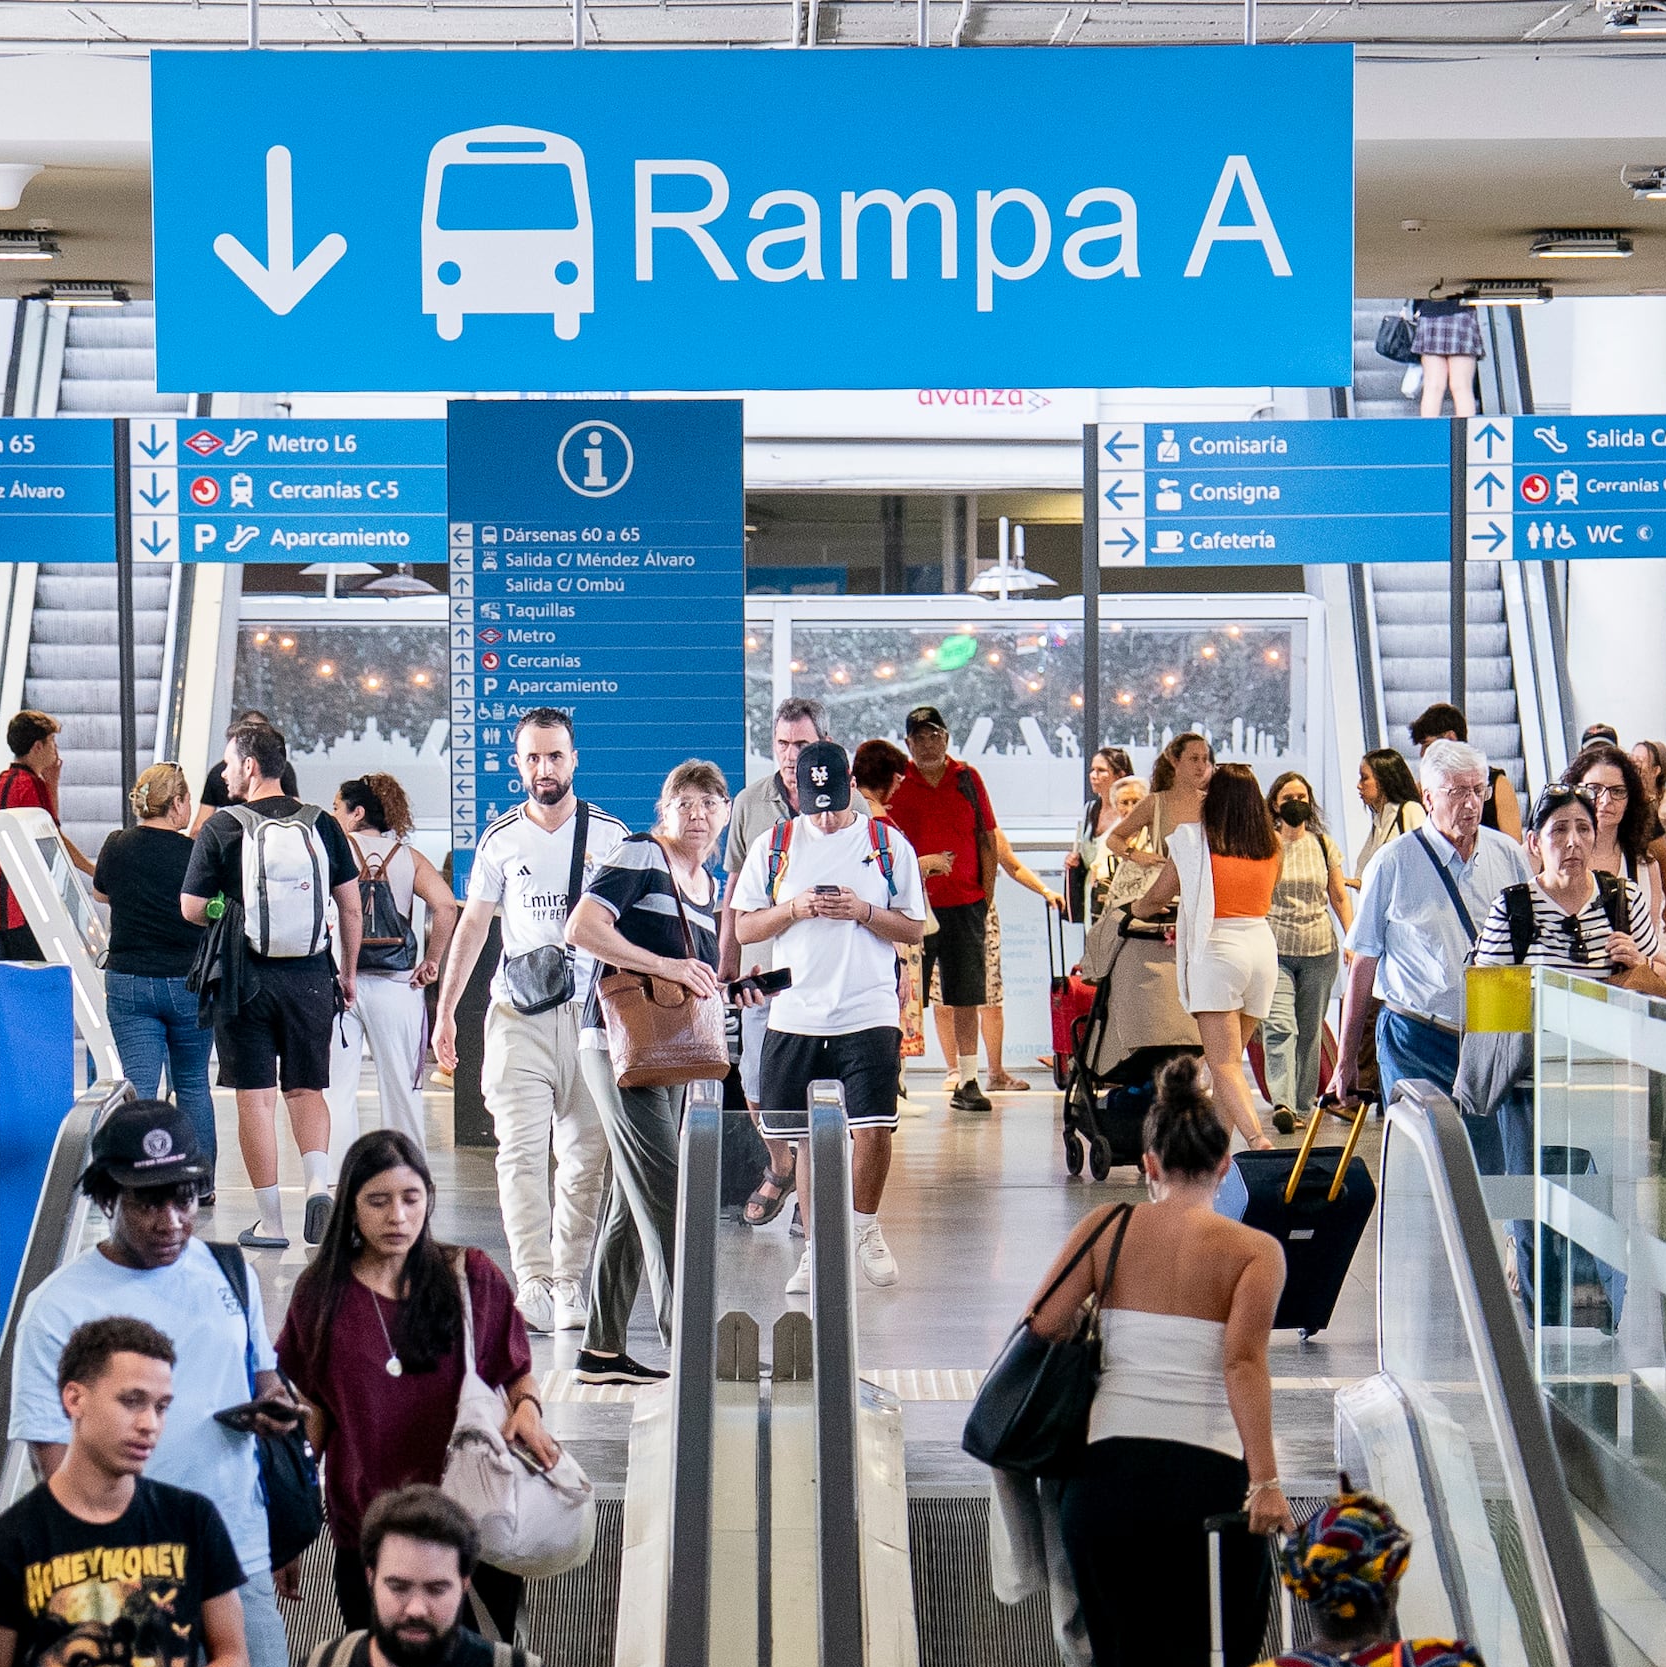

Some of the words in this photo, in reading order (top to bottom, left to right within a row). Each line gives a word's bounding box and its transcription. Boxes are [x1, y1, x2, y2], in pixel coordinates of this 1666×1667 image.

[634, 158, 1141, 313] Rampa
[1183, 155, 1293, 277] A
[918, 388, 1023, 405] avanza
[9, 435, 35, 454] 65
[267, 434, 328, 454] Metro
[332, 434, 357, 454] L6
[1189, 434, 1288, 456] Comisaría
[1587, 428, 1645, 448] Salida
[10, 480, 65, 498] Álvaro
[269, 479, 362, 500] Cercanías
[367, 481, 399, 499] C-5
[1189, 481, 1281, 505] Consigna
[1586, 475, 1659, 493] Cercanías
[270, 527, 410, 549] Aparcamiento
[503, 527, 577, 542] Dársenas
[581, 527, 602, 542] 60
[606, 531, 616, 542] a
[620, 527, 640, 542] 65
[1189, 529, 1276, 551] Cafetería
[1587, 524, 1624, 543] WC
[506, 552, 552, 567] Salida
[557, 552, 571, 567] C/
[577, 551, 639, 567] Méndez
[644, 550, 695, 567] Álvaro
[506, 577, 552, 592] Salida
[557, 577, 572, 592] C/
[577, 577, 625, 592] Ombú
[506, 602, 575, 620] Taquillas
[507, 629, 556, 643] Metro
[507, 653, 581, 668] Cercanías
[507, 678, 618, 695] Aparcamiento
